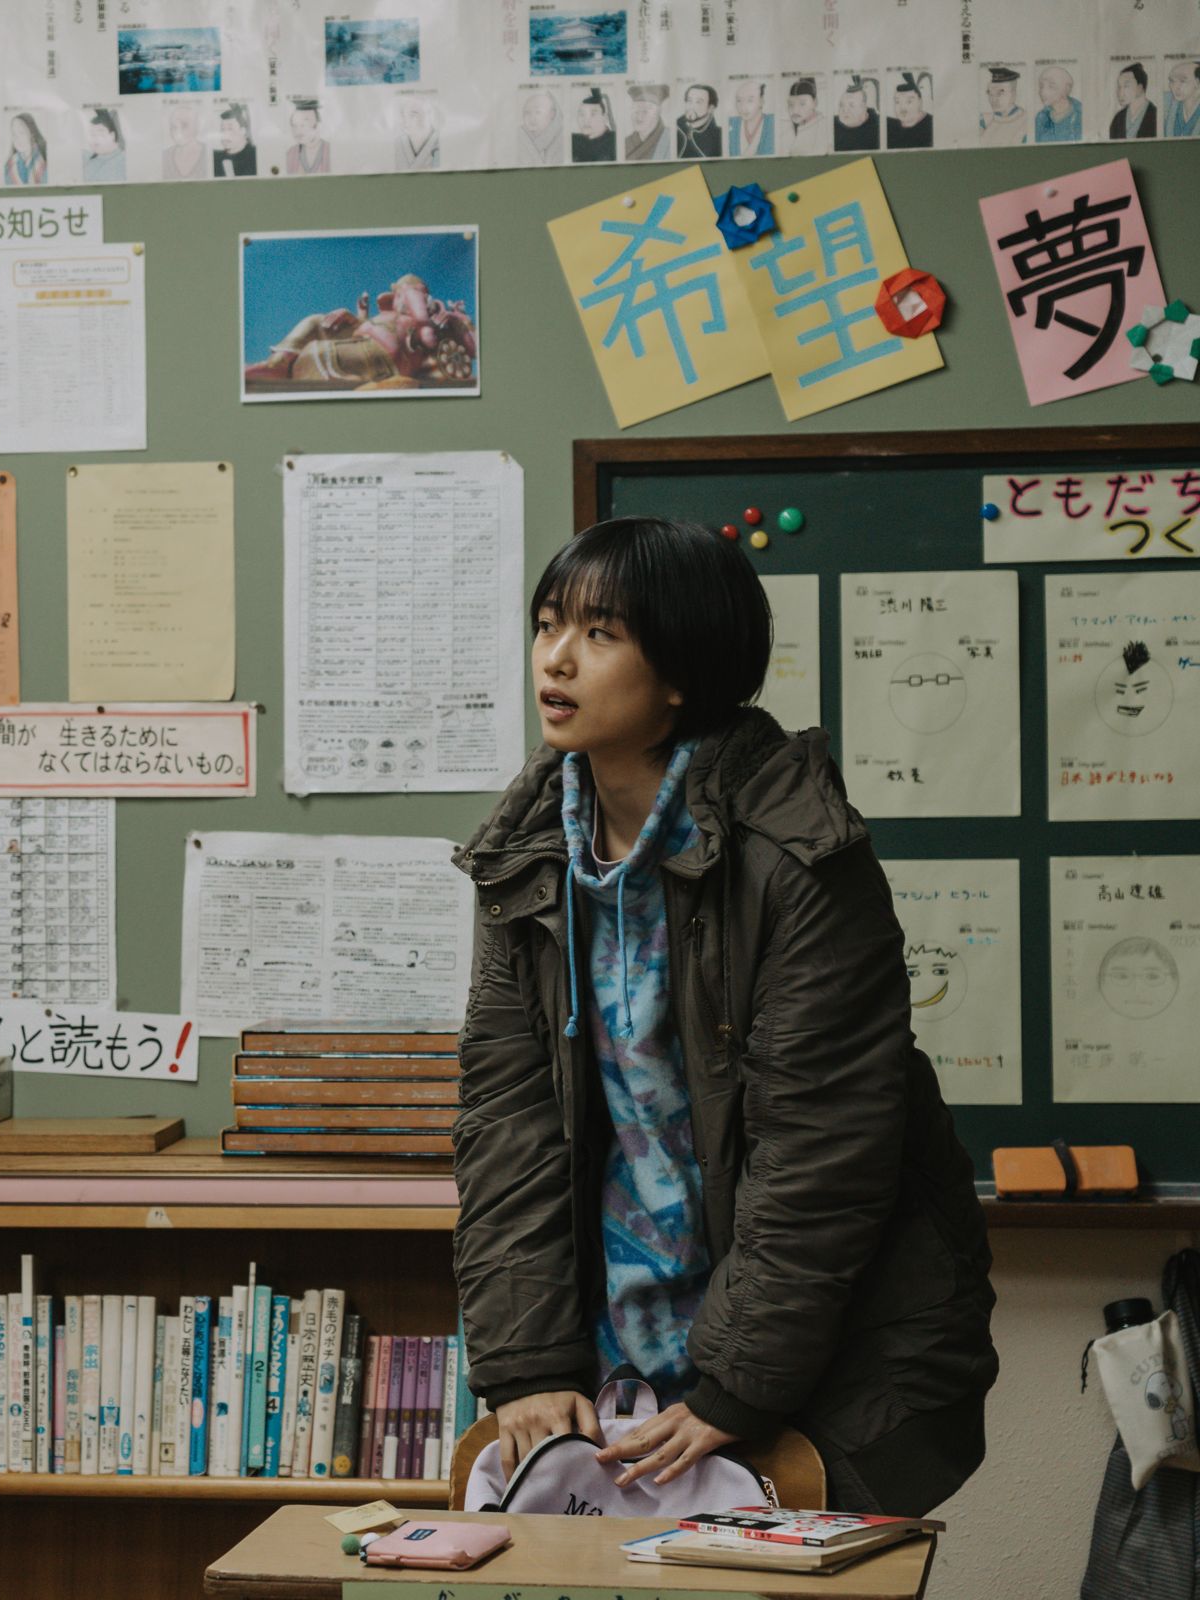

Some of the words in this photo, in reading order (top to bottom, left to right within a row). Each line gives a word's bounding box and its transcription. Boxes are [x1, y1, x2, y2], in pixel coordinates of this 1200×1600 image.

[998, 194, 1145, 382] 夢
[1006, 472, 1200, 519] ともだち
[1109, 518, 1194, 555] つく
[59, 722, 178, 747] 生きるために
[39, 750, 245, 776] なくてはならないもの。
[323, 1297, 338, 1361] 赤毛のポチ
